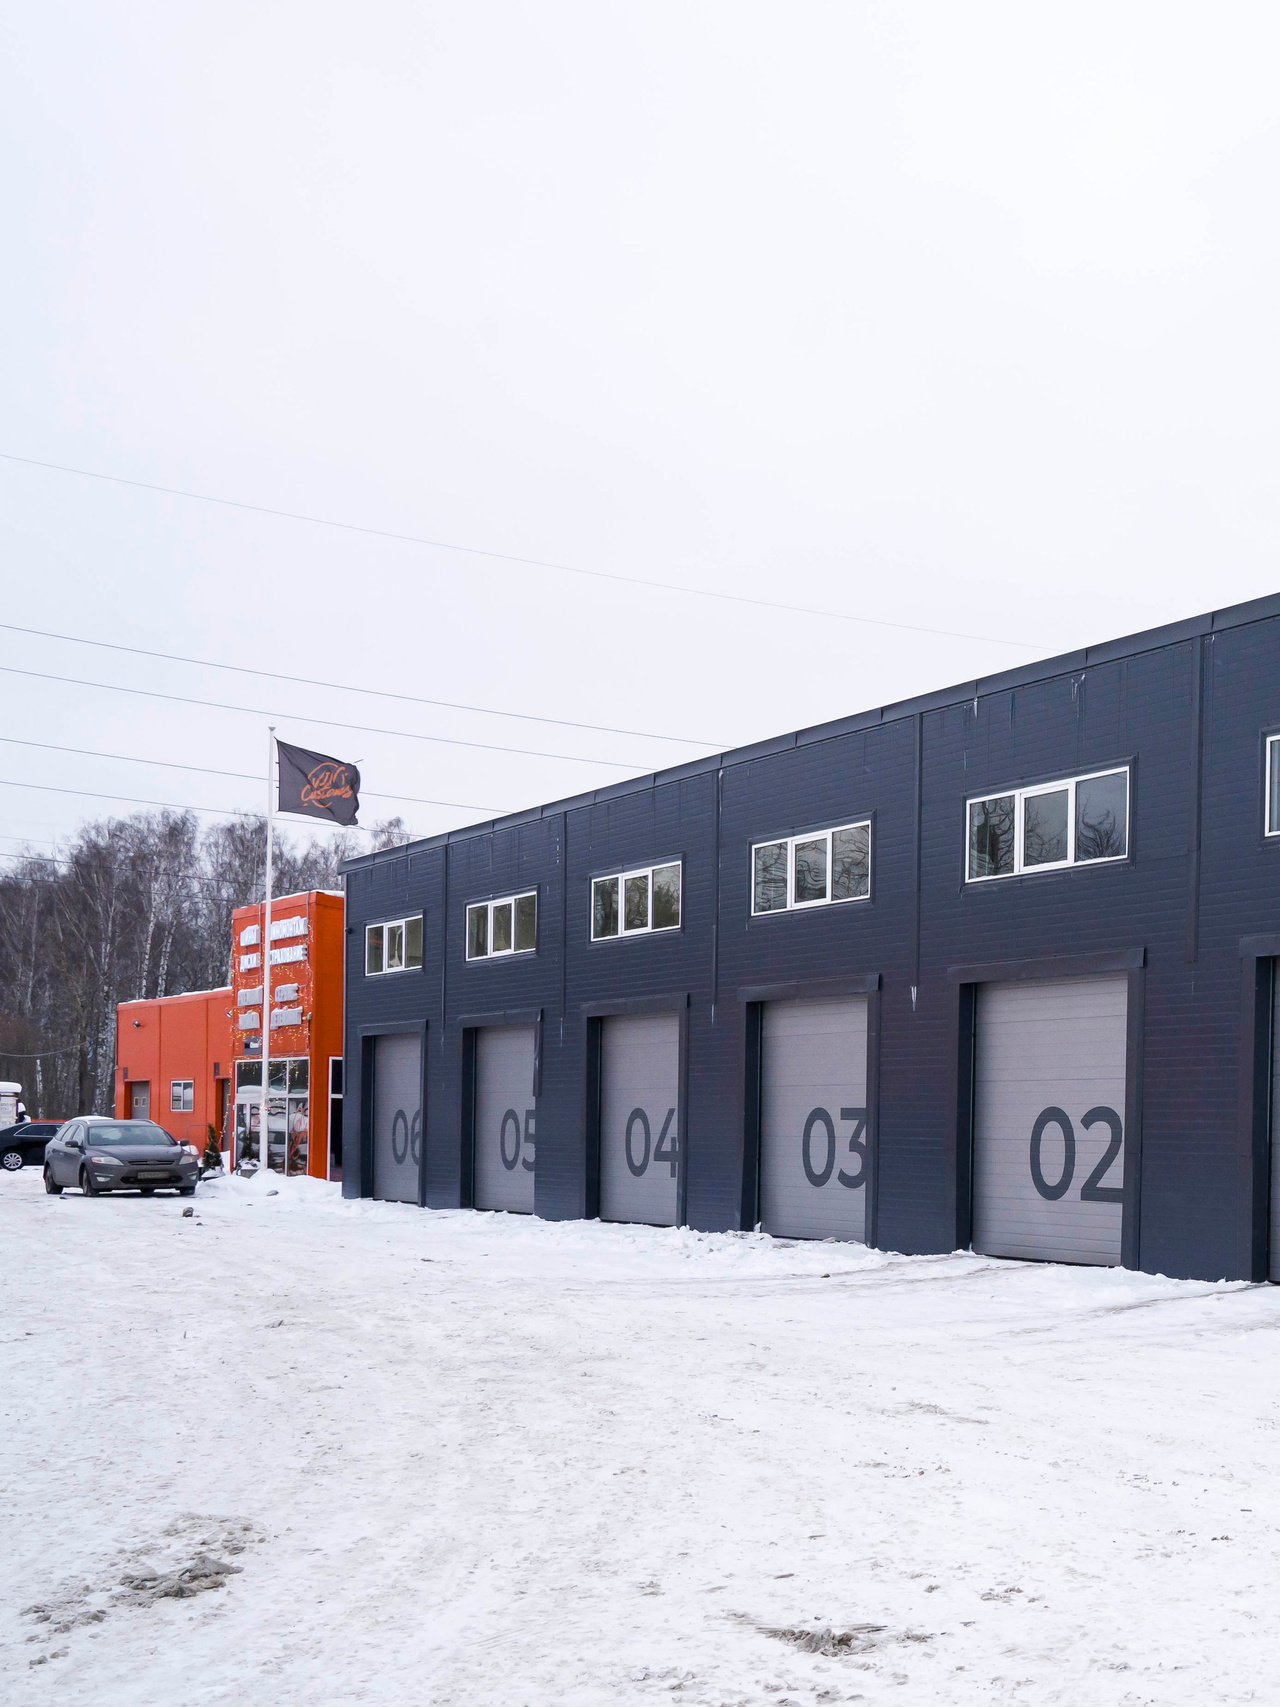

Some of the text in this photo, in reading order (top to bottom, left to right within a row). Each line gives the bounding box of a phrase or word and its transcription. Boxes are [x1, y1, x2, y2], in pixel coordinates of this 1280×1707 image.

[500, 1108, 536, 1172] 05
[625, 1107, 679, 1178] 04
[802, 1106, 867, 1189] 03
[1030, 1106, 1123, 1203] 02
